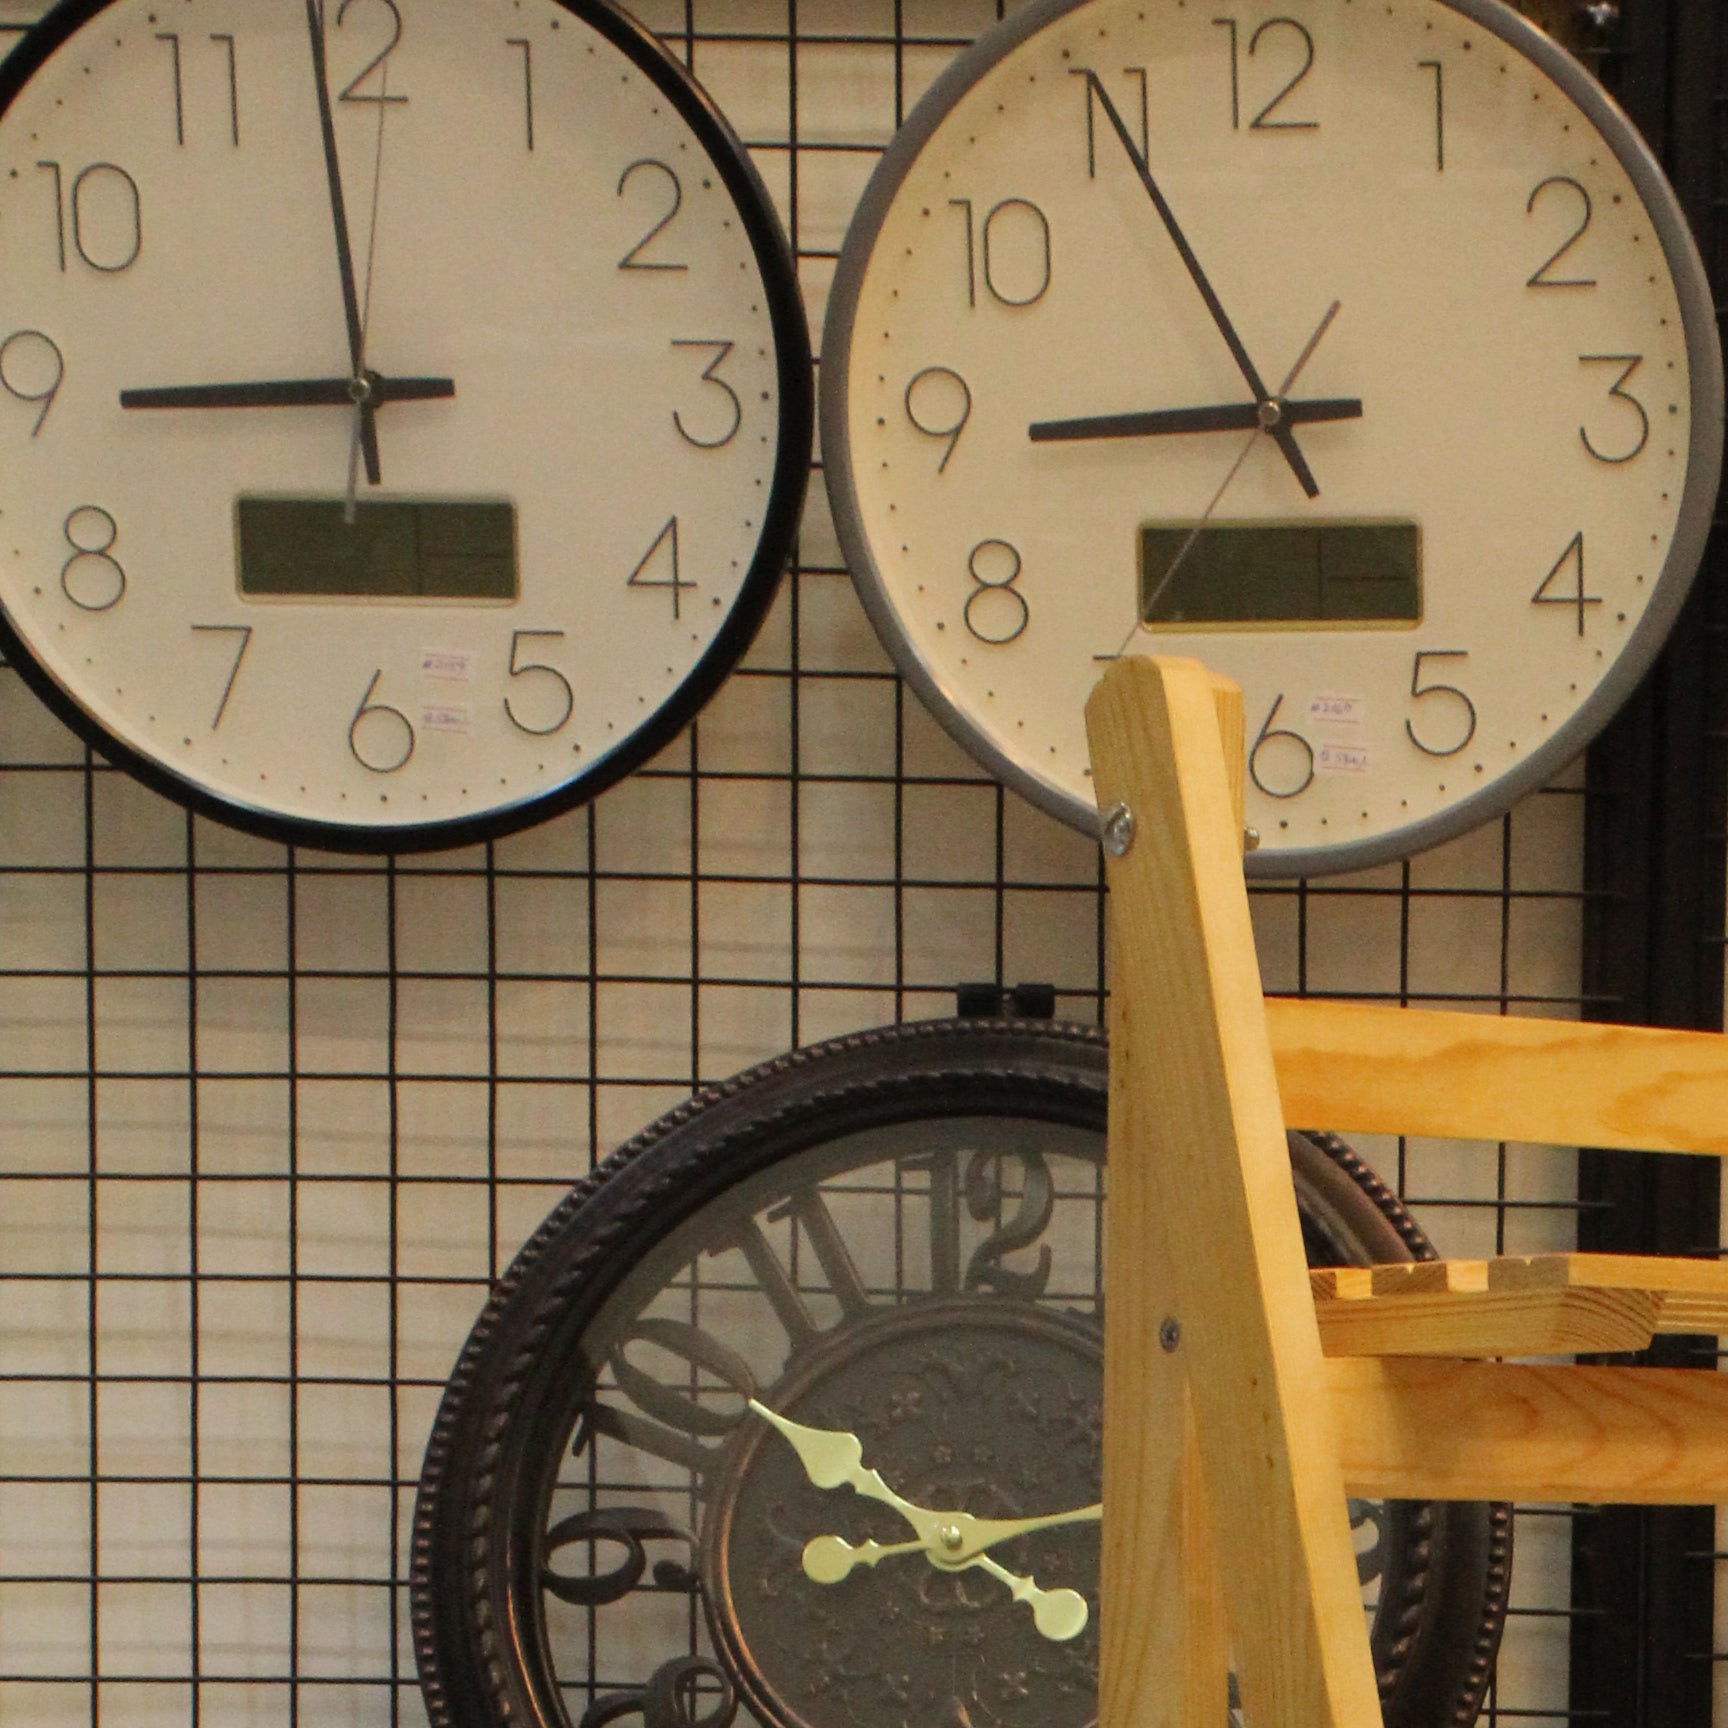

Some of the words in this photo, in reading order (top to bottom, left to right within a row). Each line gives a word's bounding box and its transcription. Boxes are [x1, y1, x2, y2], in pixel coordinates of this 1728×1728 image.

[154, 33, 238, 145] 11
[506, 39, 533, 151] 1
[1069, 69, 1149, 178] 11
[1212, 18, 1319, 130] 12
[1418, 62, 1444, 171] 1
[37, 161, 142, 272] 10
[617, 159, 688, 269] 2
[949, 198, 1051, 307] 10
[1527, 176, 1597, 287] 2
[0, 330, 64, 437] 9
[672, 340, 741, 448] 3
[904, 366, 972, 473] 9
[1579, 355, 1649, 463] 3
[61, 505, 126, 610] 8
[627, 515, 696, 619] 4
[964, 538, 1029, 643] 8
[1531, 531, 1602, 636] 4
[191, 624, 253, 729] 7
[348, 668, 415, 772] 6
[504, 630, 573, 735] 5
[1406, 650, 1476, 756] 5
[1249, 693, 1315, 798] 6
[707, 1179, 869, 1340] 11
[900, 1146, 1056, 1300] 12
[573, 1318, 760, 1473] 10
[542, 1507, 699, 1607] 9
